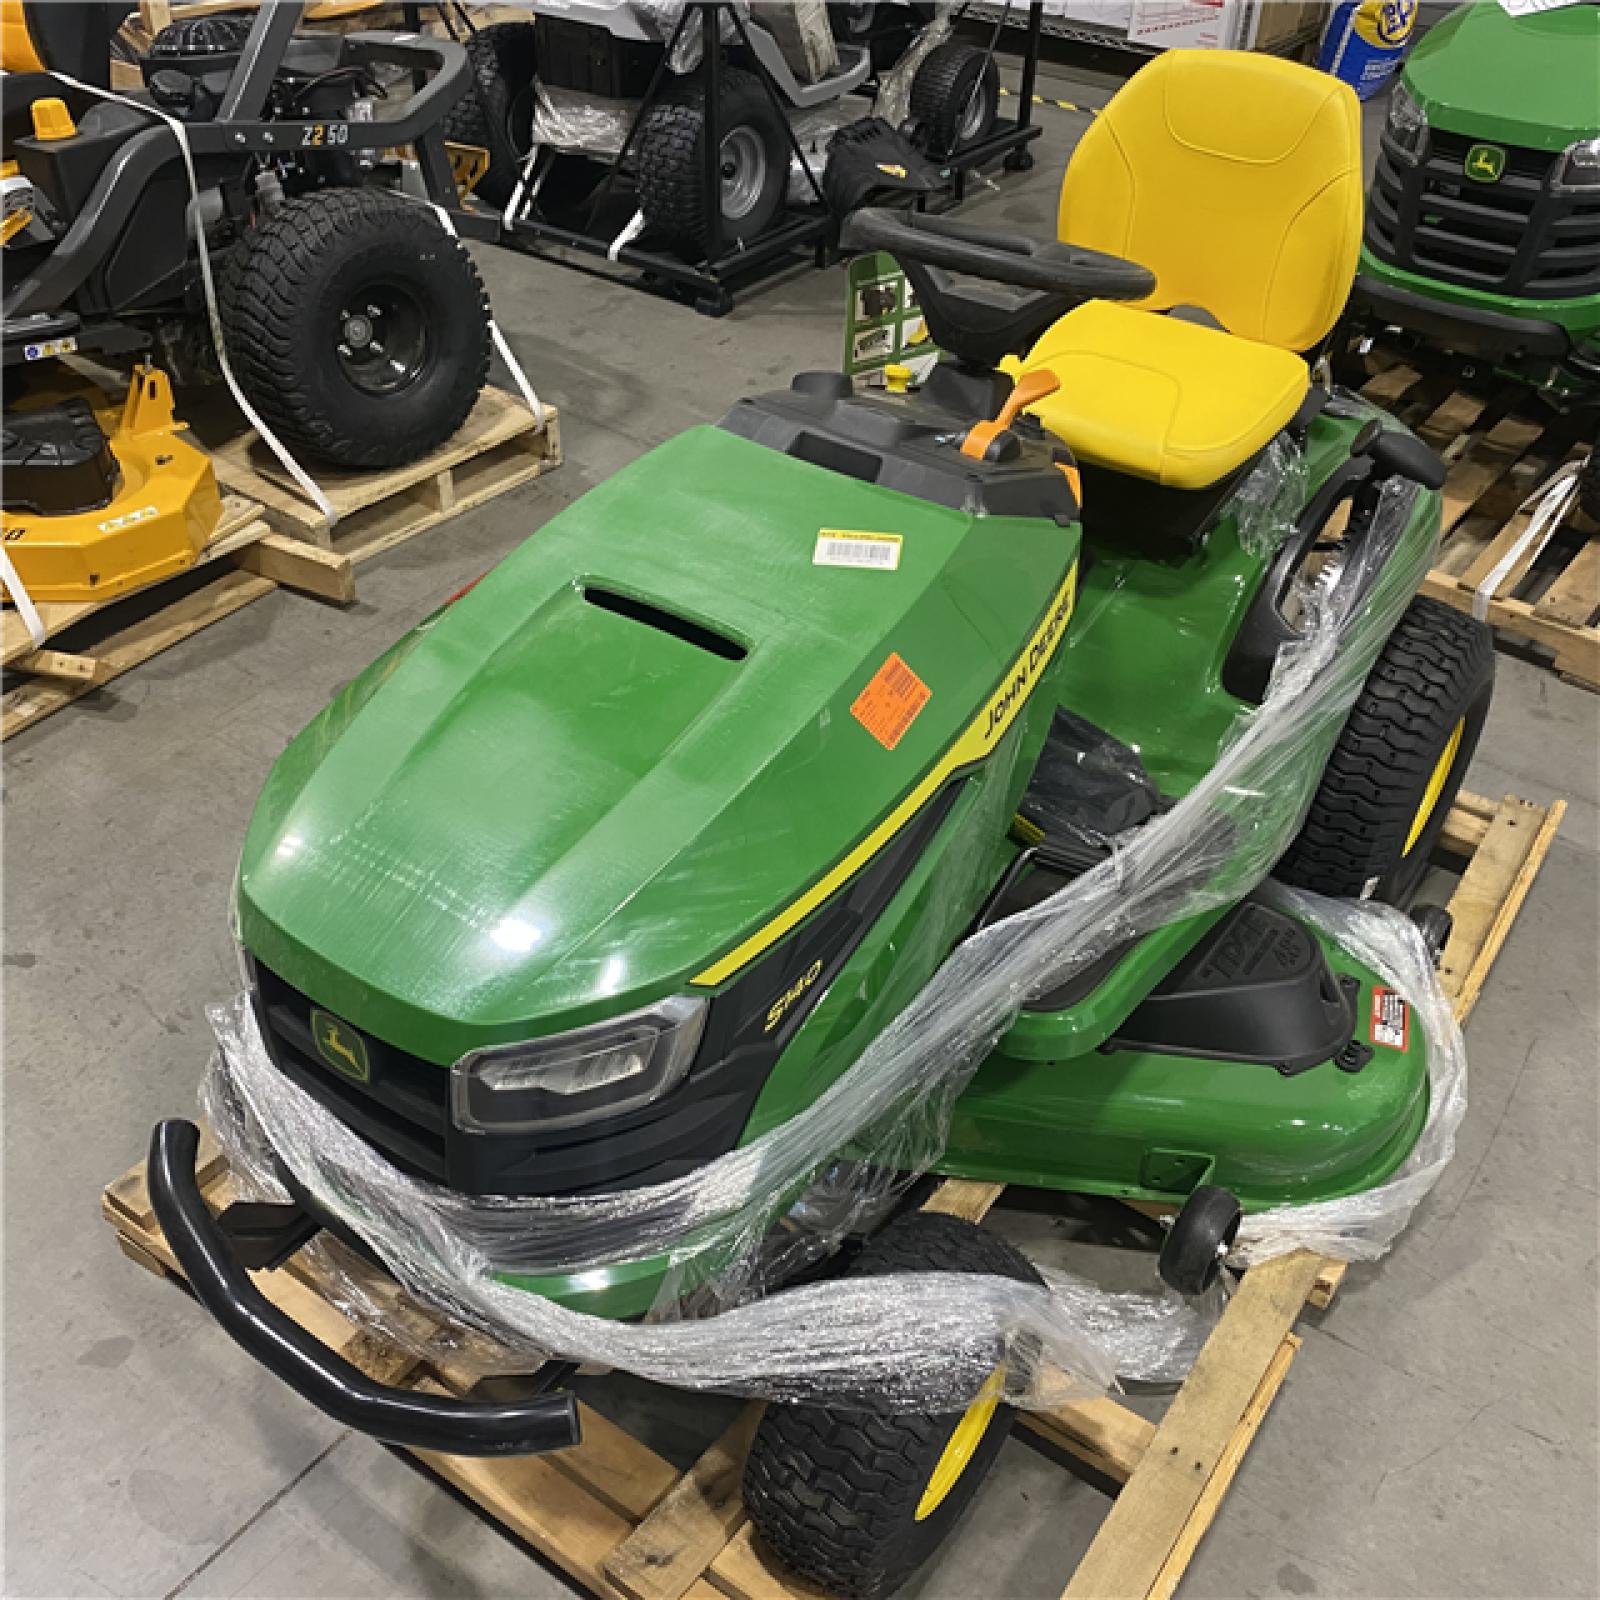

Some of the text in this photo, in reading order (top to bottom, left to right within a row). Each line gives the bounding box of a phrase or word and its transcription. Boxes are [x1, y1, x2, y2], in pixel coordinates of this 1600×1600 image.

[984, 588, 1071, 740] JOHN DEERE
[764, 959, 823, 1032] S140
